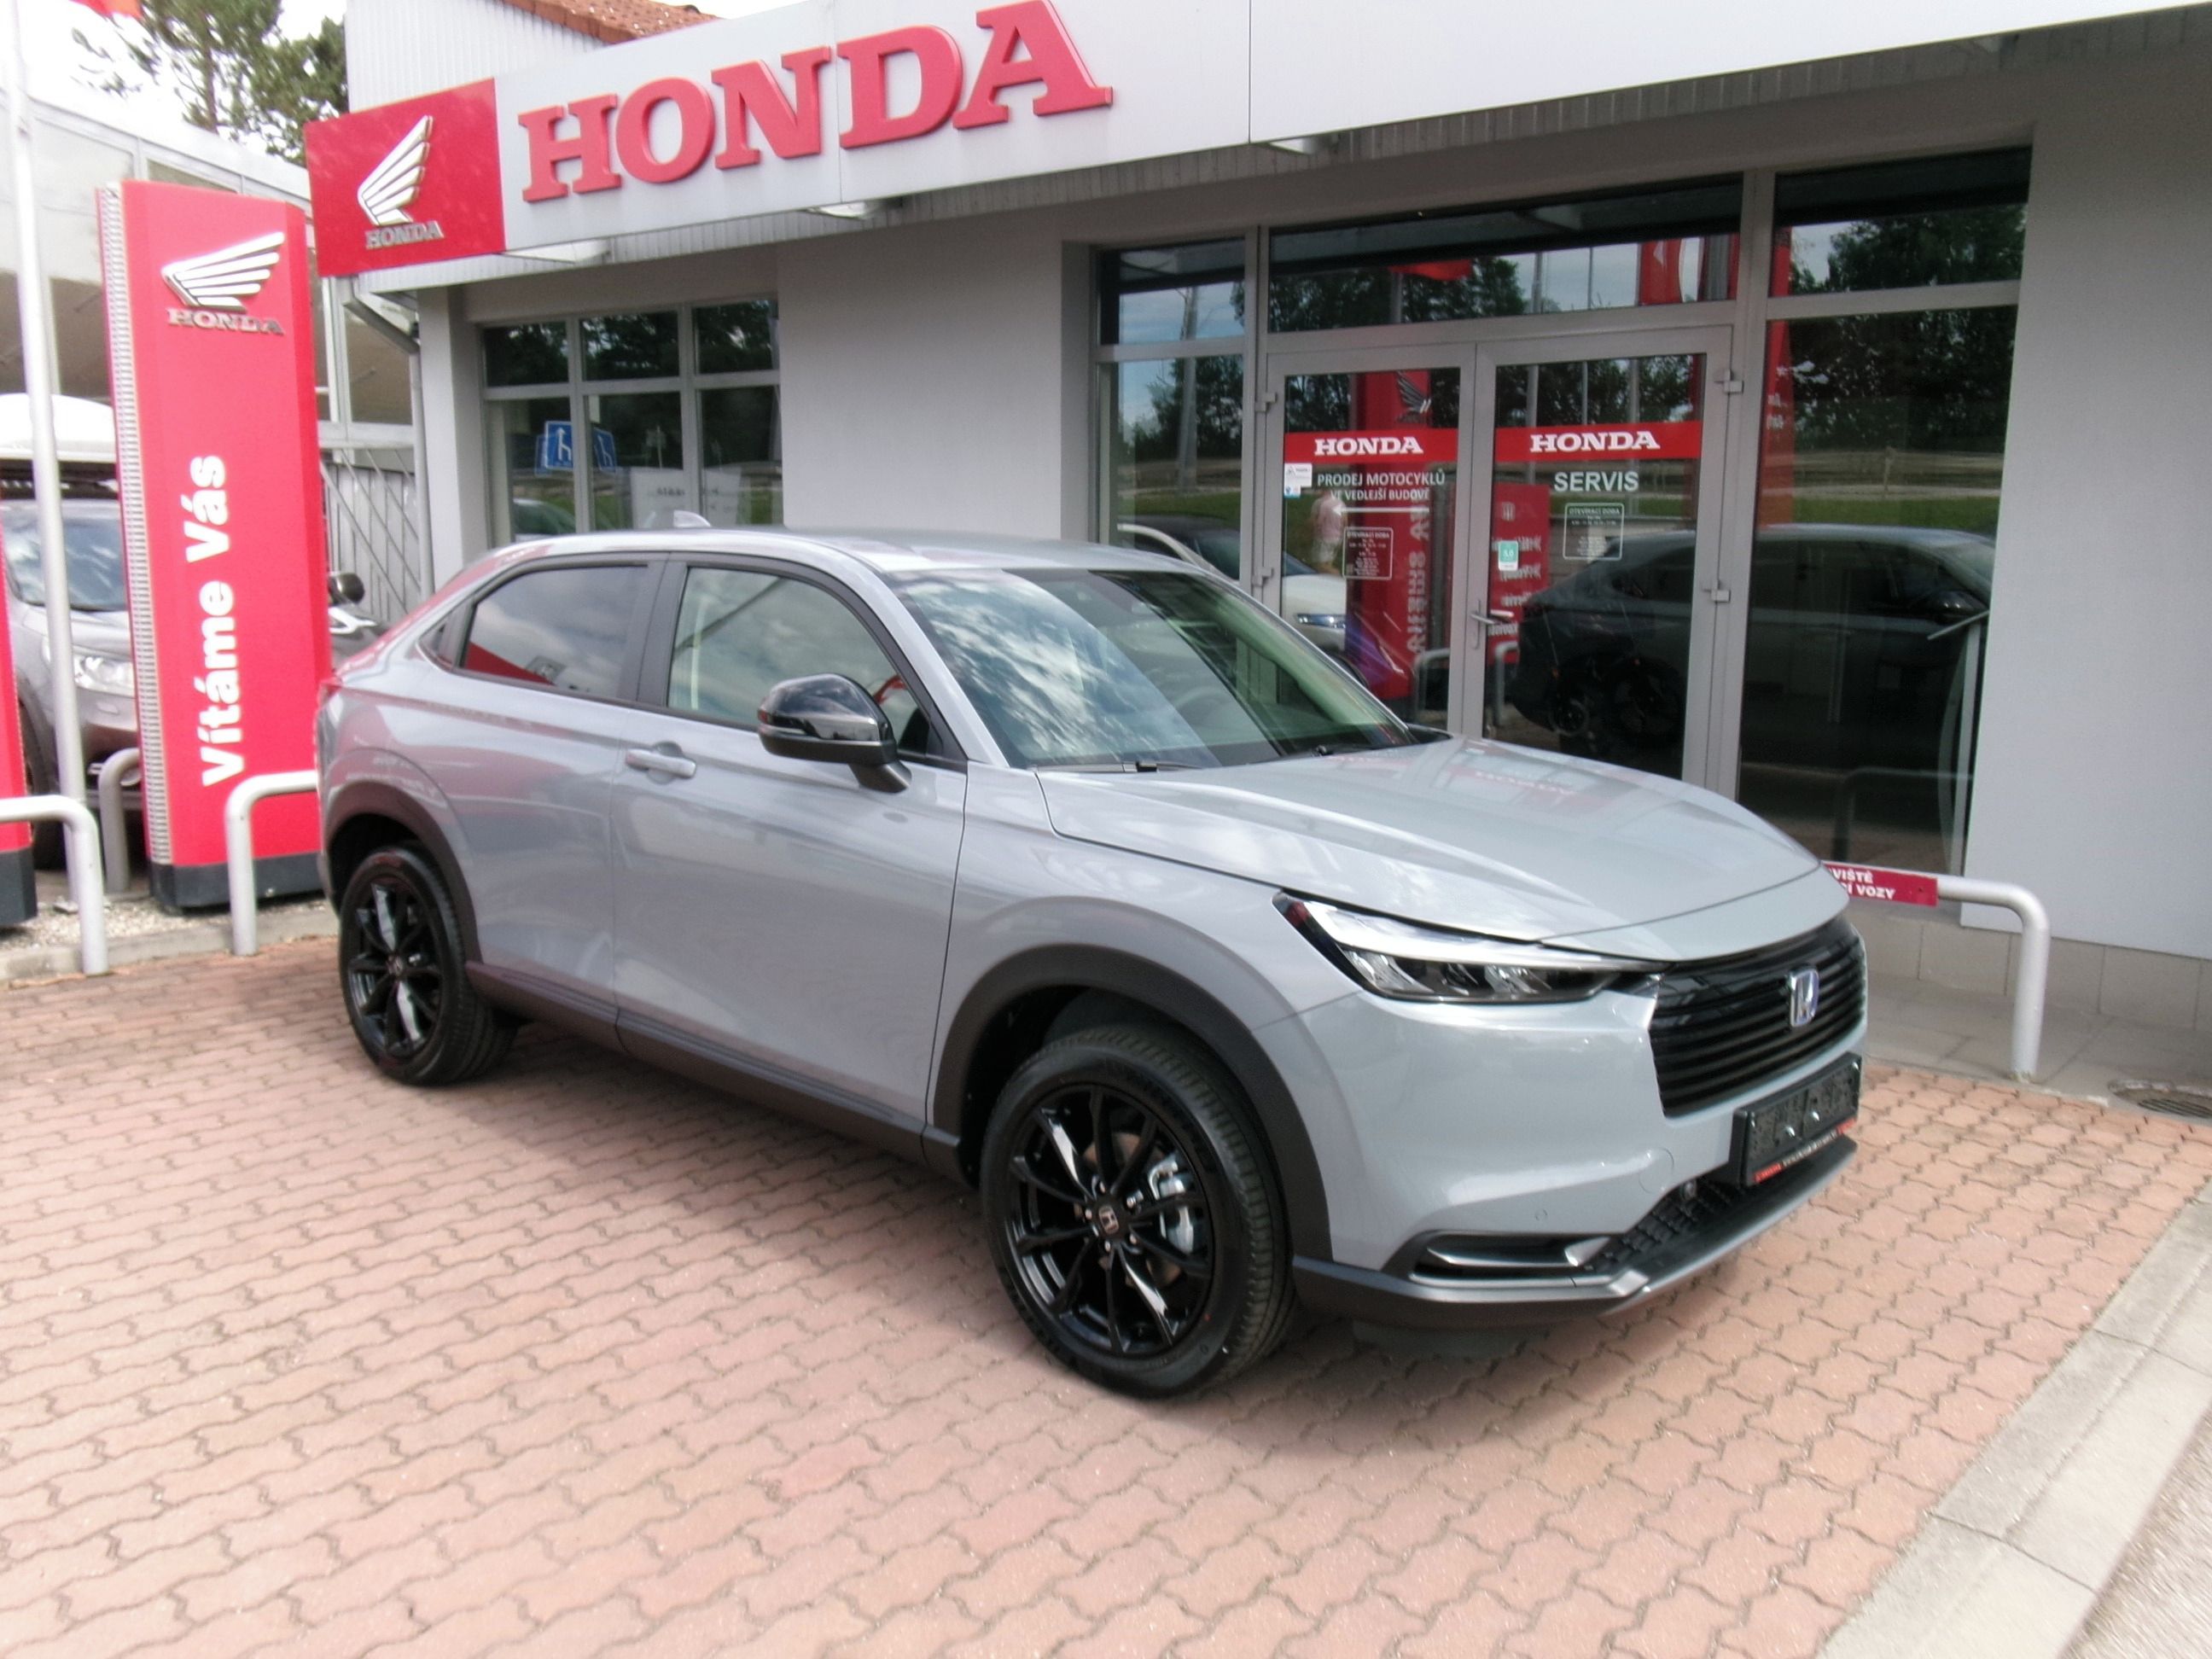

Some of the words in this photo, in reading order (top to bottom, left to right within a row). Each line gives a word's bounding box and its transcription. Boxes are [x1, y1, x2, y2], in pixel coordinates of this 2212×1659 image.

[518, 0, 1112, 202] HONDA
[365, 220, 444, 249] HONDA
[166, 307, 284, 335] HONDA
[1314, 436, 1423, 457] HONDA
[1529, 430, 1661, 453] HONDA
[1318, 473, 1363, 486] PRODEJ
[1366, 469, 1446, 486] MOTOCYKLŮ
[1554, 471, 1639, 492] SERVIS
[1345, 487, 1386, 501] VEDLEJŠÍ
[181, 455, 230, 563] Vás
[195, 580, 245, 787] Vítáme
[1830, 866, 1874, 884] VIŠTĚ
[1856, 884, 1896, 899] VOZY
